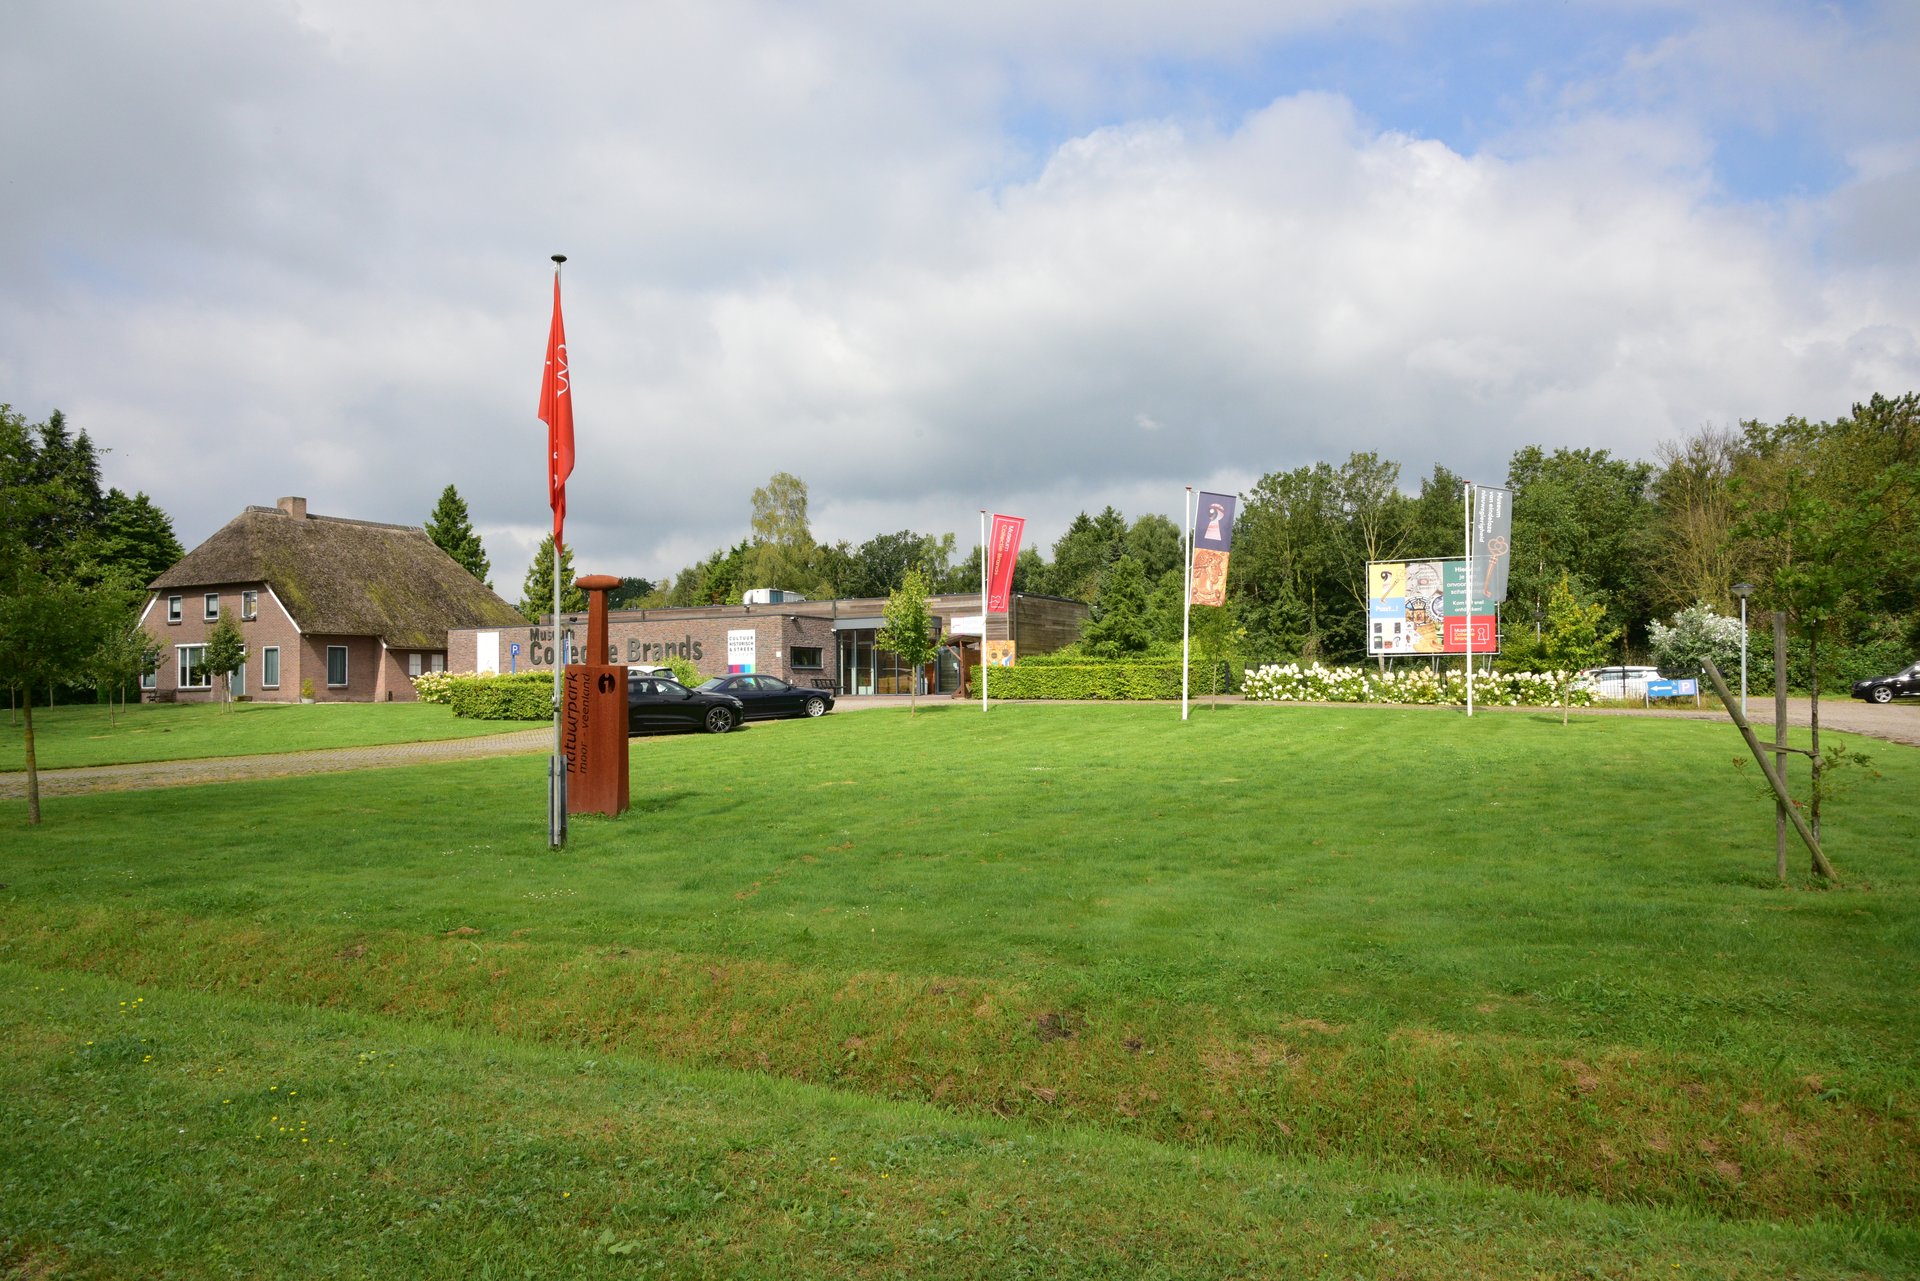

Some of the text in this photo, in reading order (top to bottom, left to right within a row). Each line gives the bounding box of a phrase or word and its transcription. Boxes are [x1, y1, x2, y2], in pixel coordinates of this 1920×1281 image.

[1005, 525, 1014, 552] Museum
[628, 634, 702, 662] Brands
[582, 673, 590, 729] veenland
[1682, 682, 1690, 692] P
[565, 672, 580, 773] natuurpark
[580, 743, 588, 774] moor
